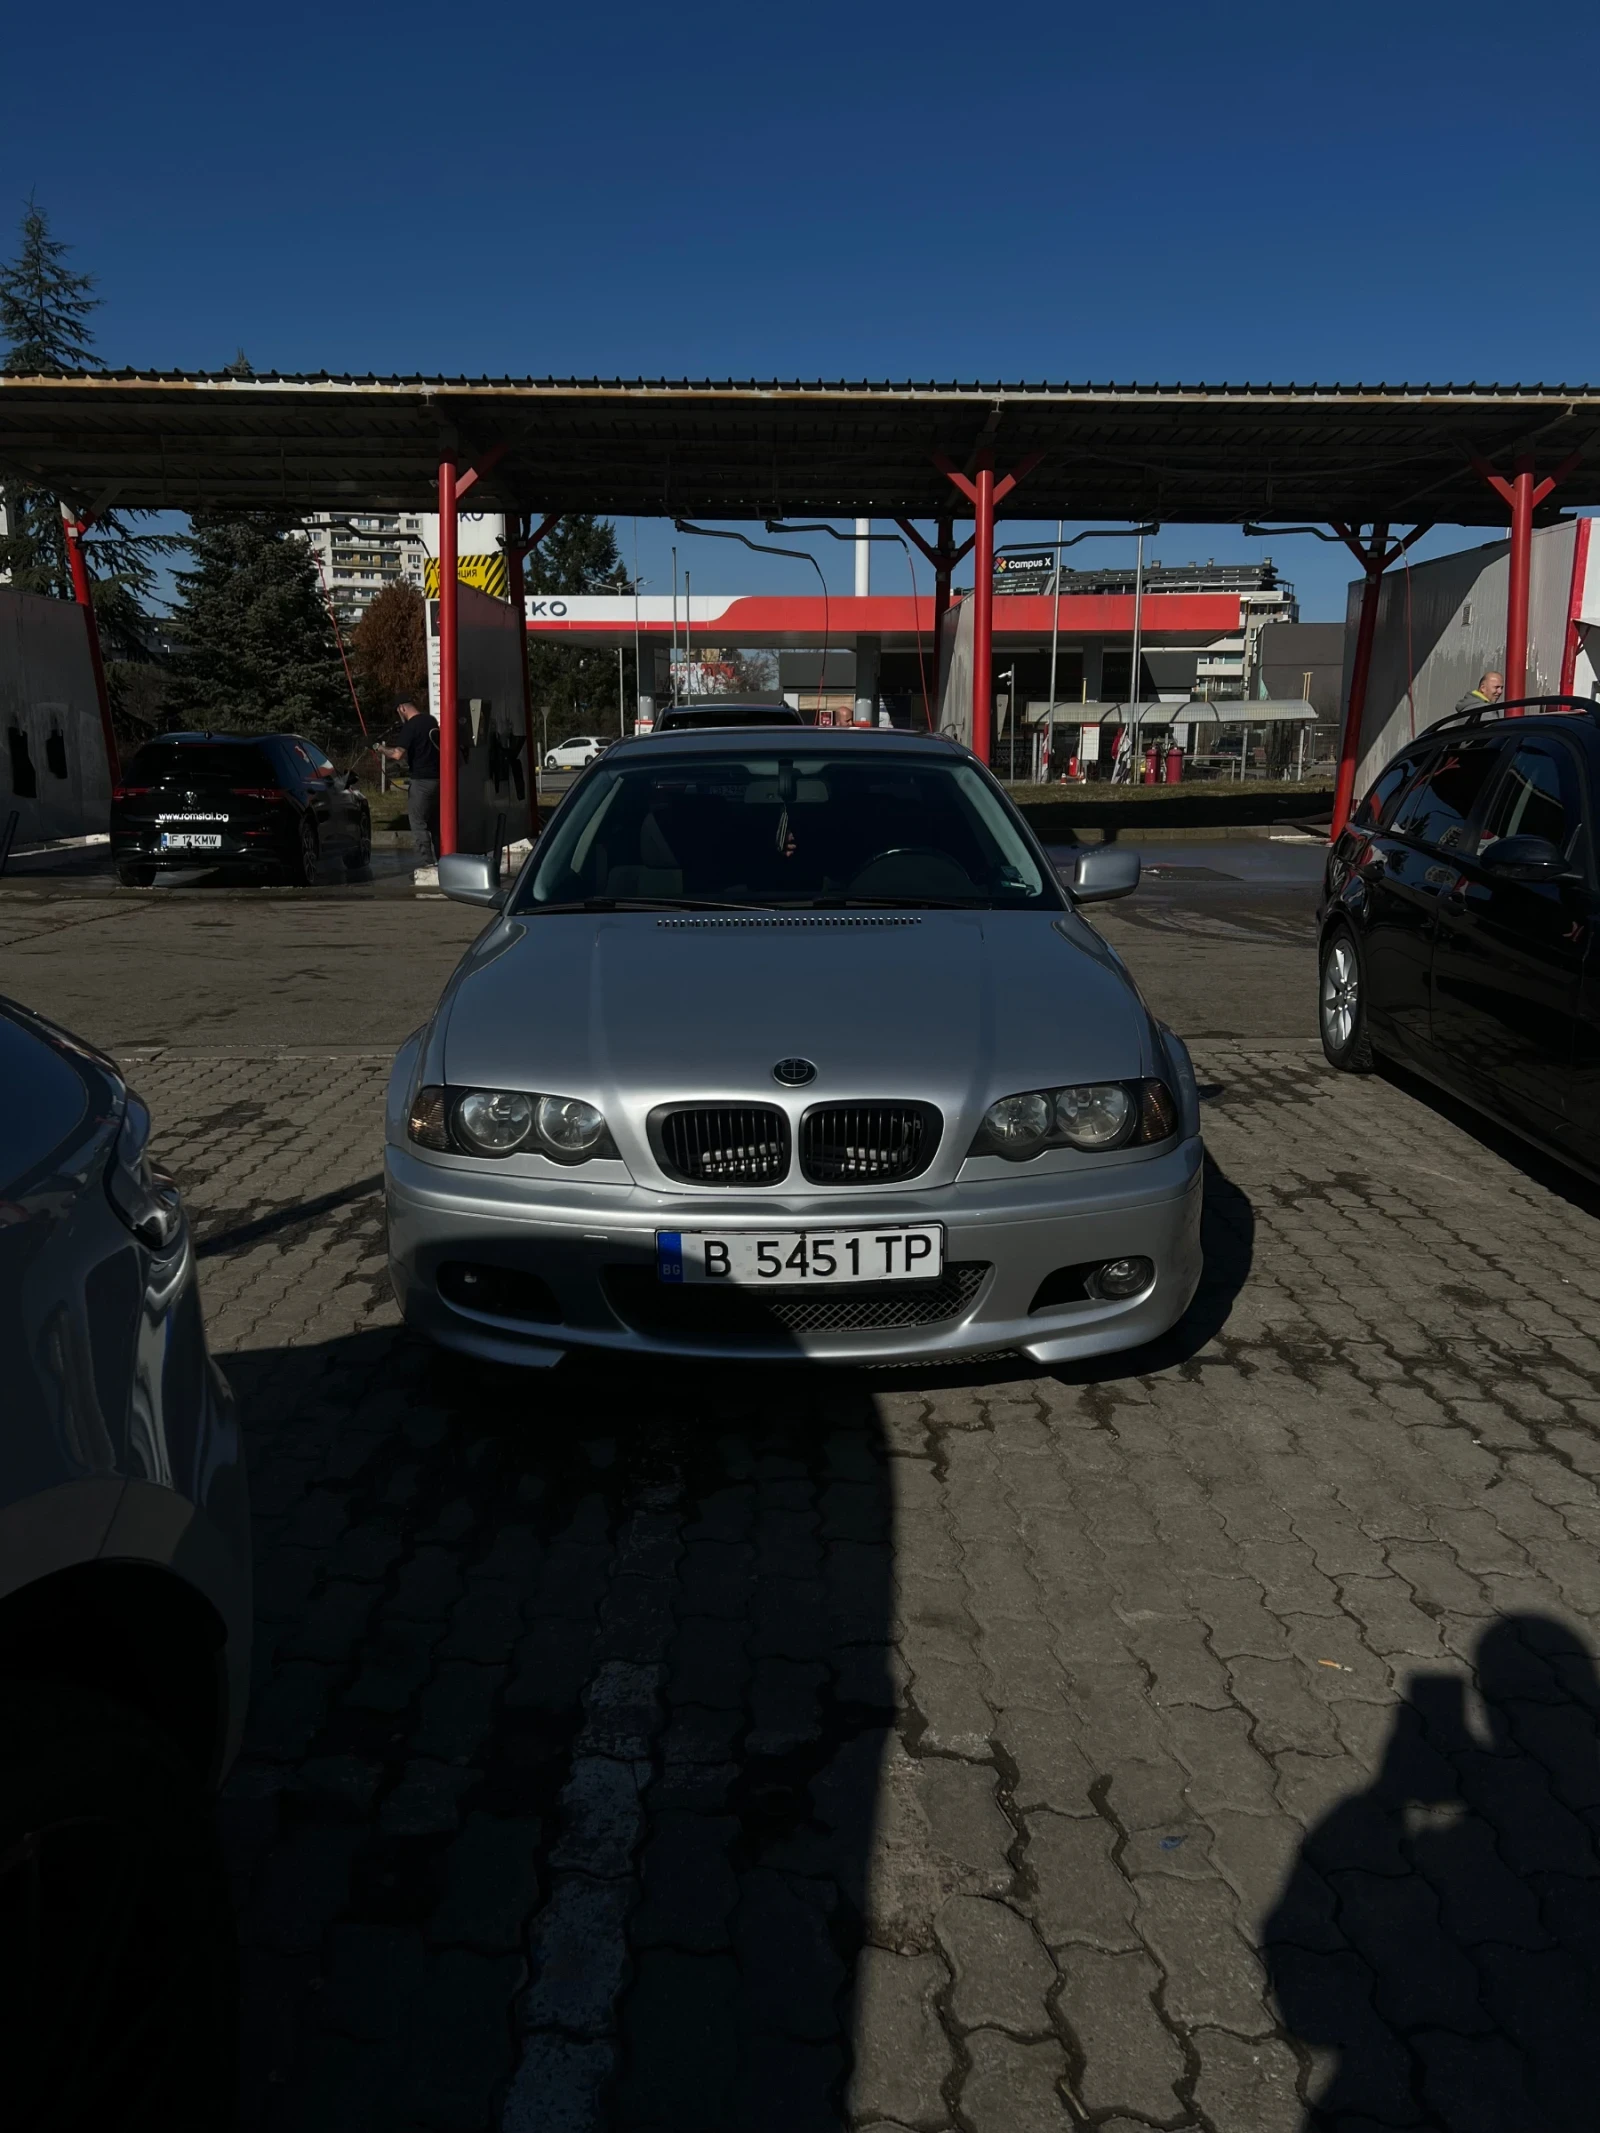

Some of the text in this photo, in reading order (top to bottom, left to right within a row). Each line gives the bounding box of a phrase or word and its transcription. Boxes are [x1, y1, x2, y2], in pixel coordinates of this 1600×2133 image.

[1008, 557, 1051, 570] Campus X
[524, 601, 567, 617] KO
[182, 835, 191, 845] 17
[194, 835, 217, 845] KMW
[704, 1235, 932, 1277] B 5451 TP
[662, 1263, 681, 1276] BG
